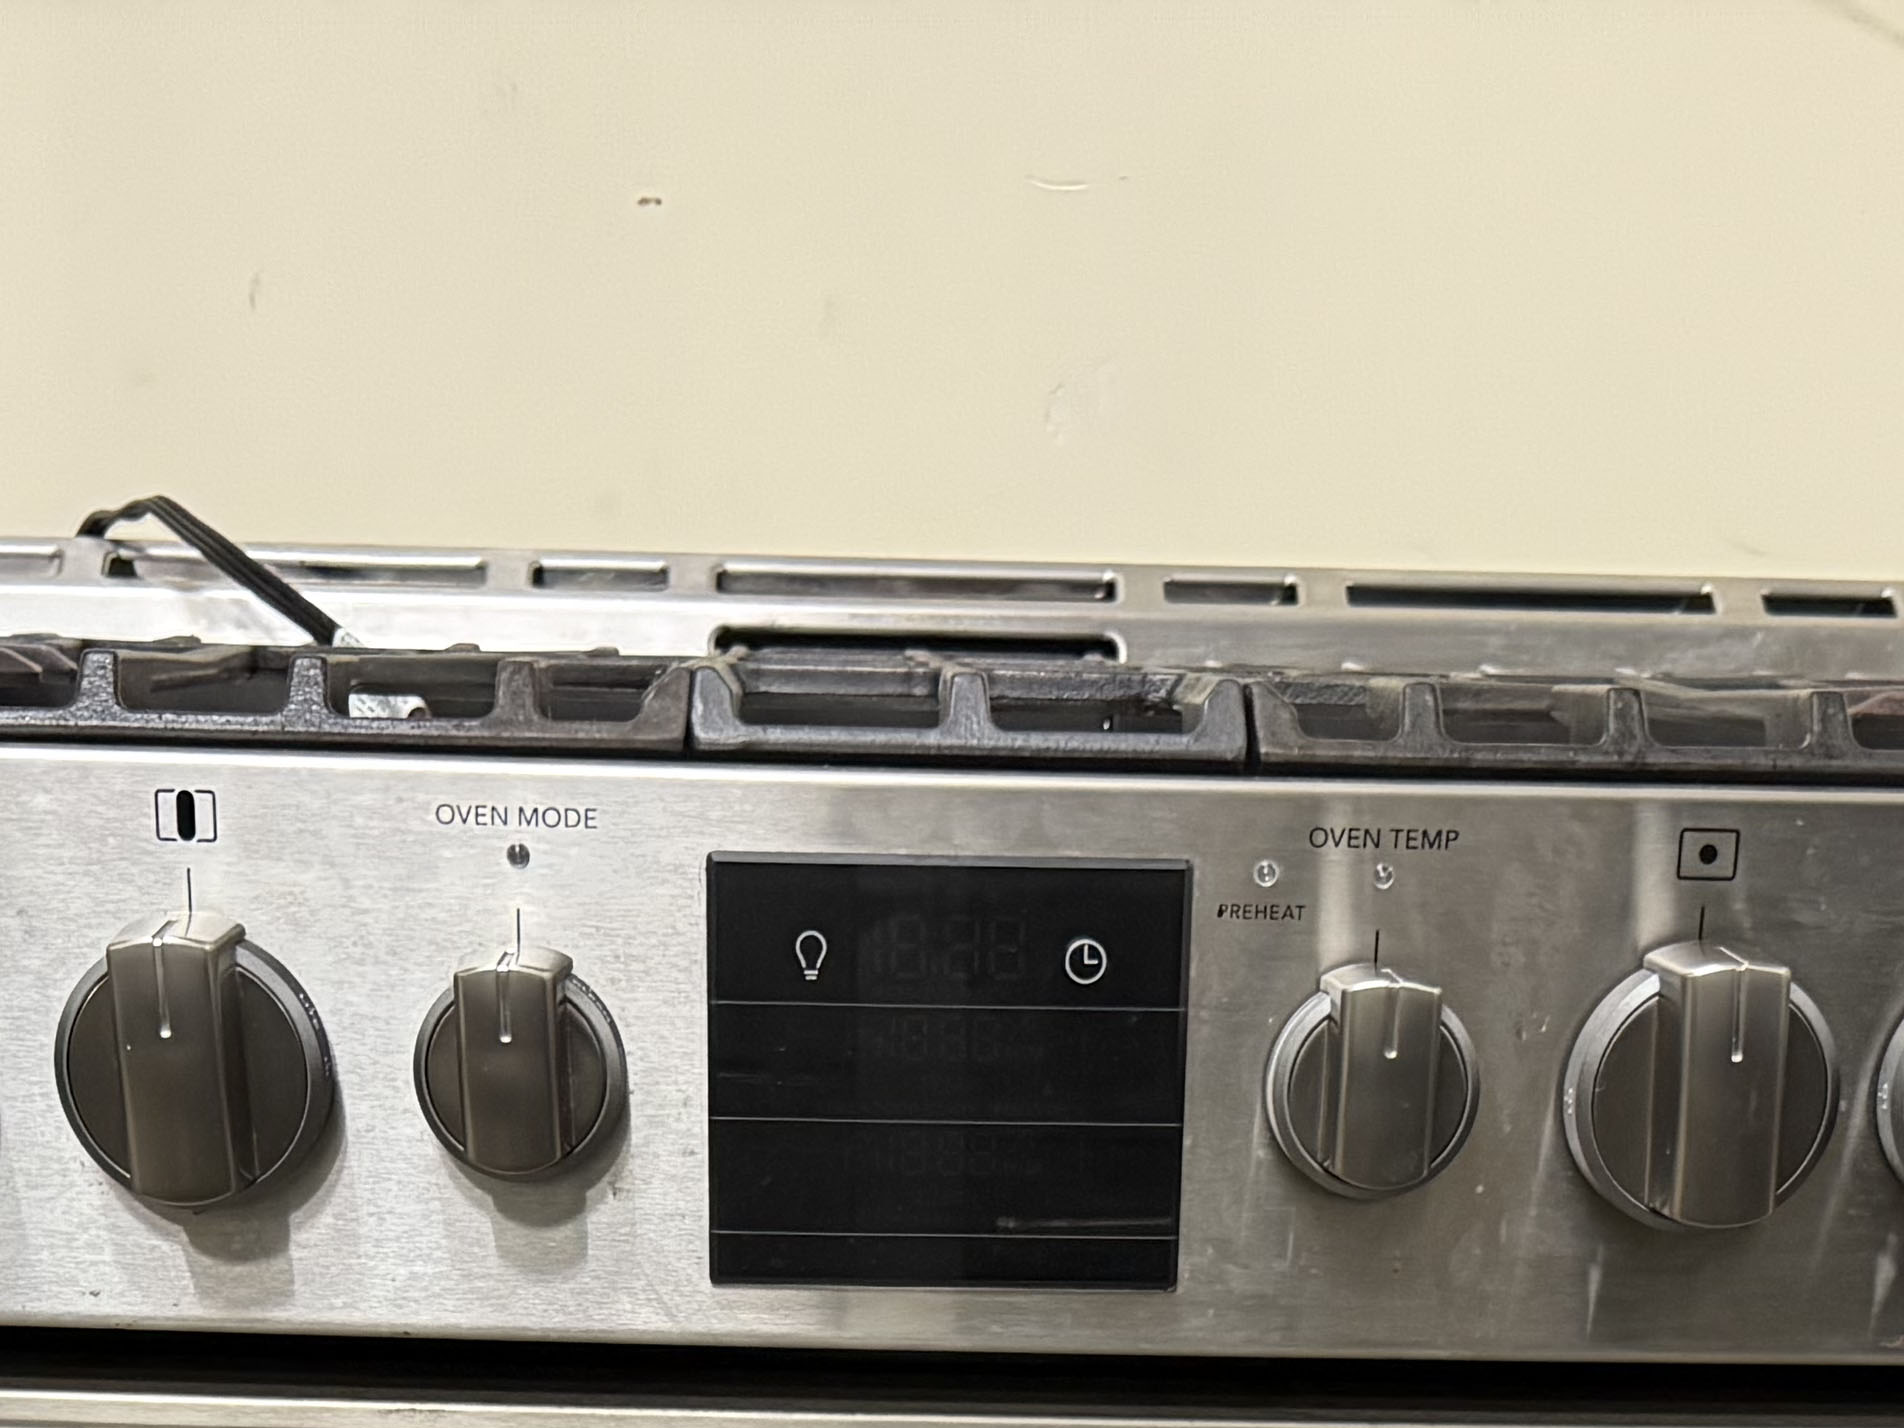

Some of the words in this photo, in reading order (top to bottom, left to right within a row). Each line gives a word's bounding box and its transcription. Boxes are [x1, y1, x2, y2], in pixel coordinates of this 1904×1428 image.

[435, 804, 508, 827] OVEN
[518, 804, 598, 830] MODE
[1309, 827, 1380, 849] OVEN
[1389, 829, 1460, 851] TEMP
[1217, 903, 1307, 921] PREHEAT
